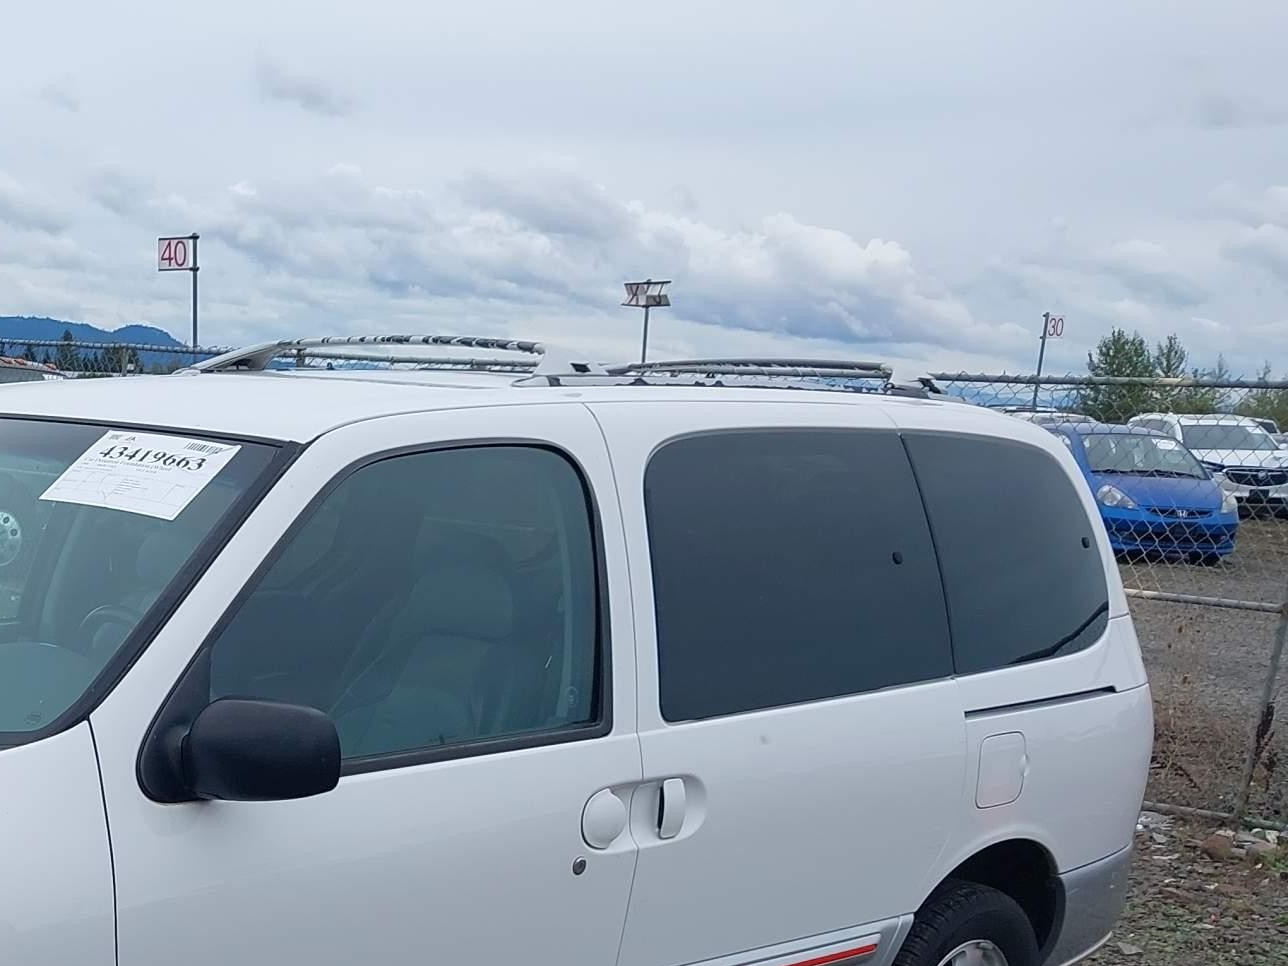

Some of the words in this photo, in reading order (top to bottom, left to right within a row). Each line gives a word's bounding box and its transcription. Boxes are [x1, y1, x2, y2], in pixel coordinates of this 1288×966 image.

[161, 240, 187, 267] 40
[1048, 317, 1064, 337] 30
[99, 445, 207, 470] 43419663
